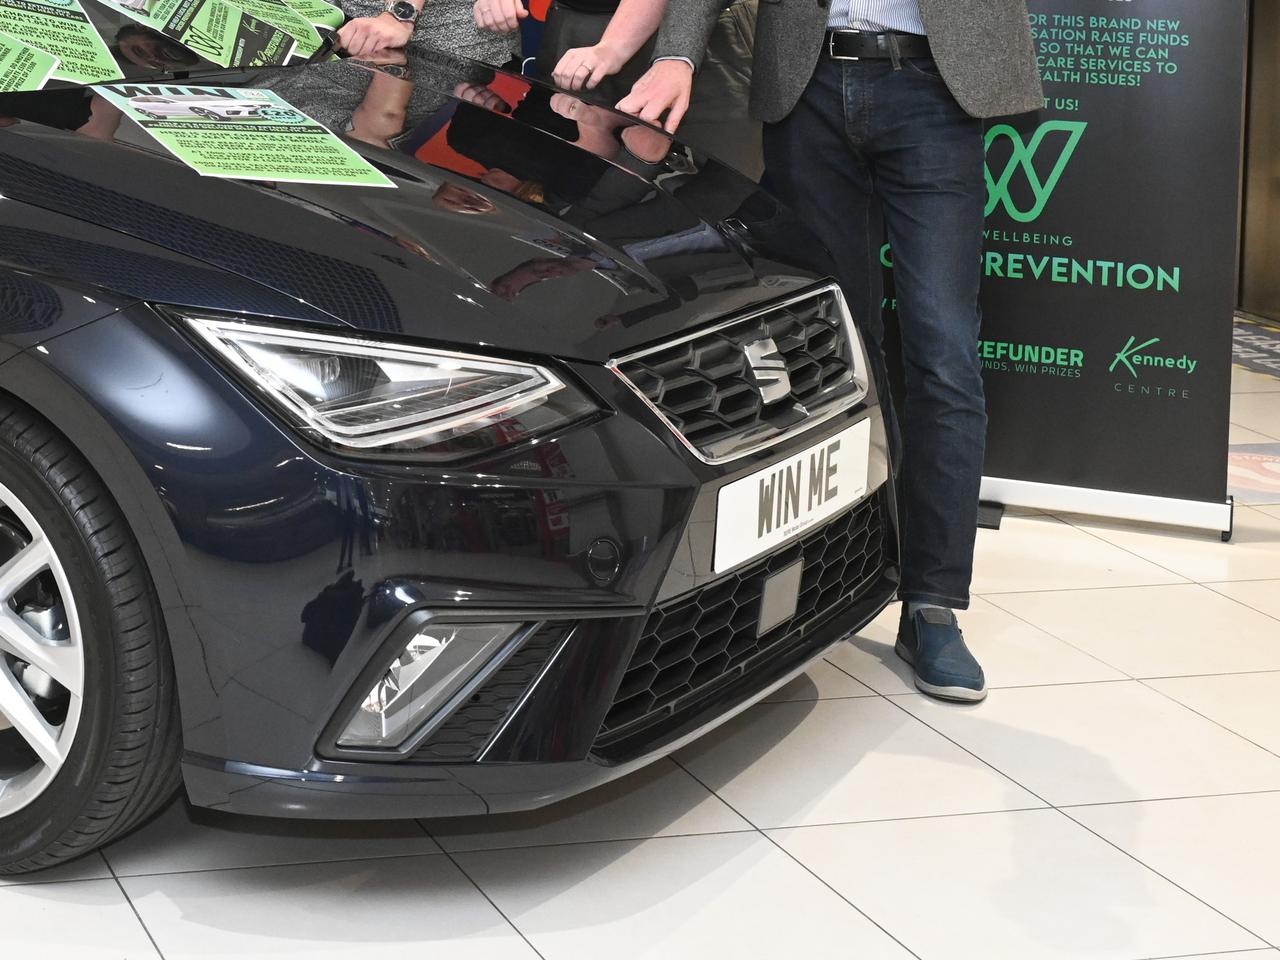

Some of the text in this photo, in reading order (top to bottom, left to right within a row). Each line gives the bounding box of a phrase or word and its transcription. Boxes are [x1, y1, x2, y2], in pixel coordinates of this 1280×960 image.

[3, 10, 41, 21] CHANCE
[1027, 13, 1180, 31] OR THIS BRAND NEW
[1091, 29, 1134, 44] RAISE
[1139, 32, 1189, 46] FUNDS
[1040, 42, 1169, 60] SO THAT WE CAN
[1037, 55, 1178, 75] CARE SERVICES TO
[1085, 71, 1141, 87] ISSUES!
[1055, 98, 1079, 111] US!
[981, 253, 1180, 292] REVENTION
[1108, 335, 1198, 379] Kennedy
[1015, 362, 1037, 374] WIN
[1041, 364, 1080, 378] PRIZES
[1114, 383, 1189, 399] CENTRE
[757, 439, 841, 539] WIN ME
